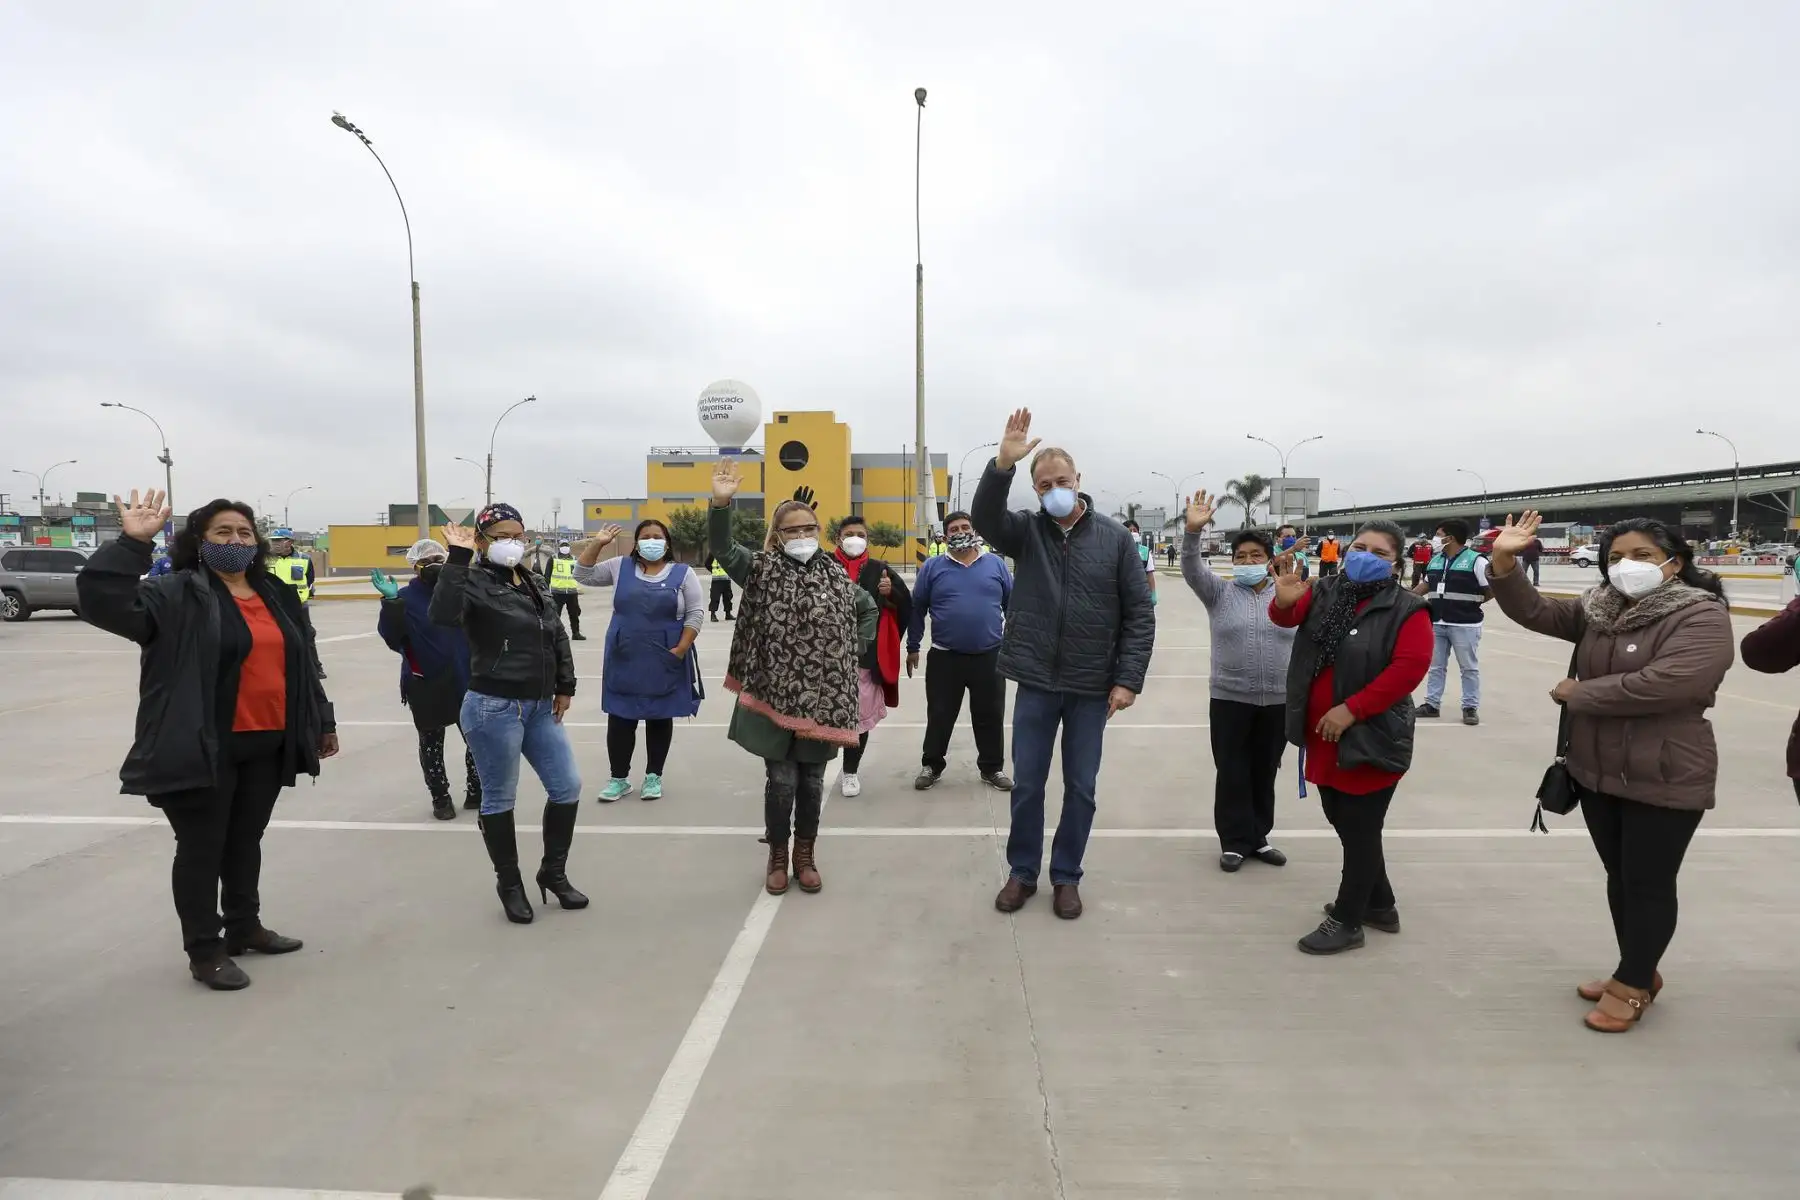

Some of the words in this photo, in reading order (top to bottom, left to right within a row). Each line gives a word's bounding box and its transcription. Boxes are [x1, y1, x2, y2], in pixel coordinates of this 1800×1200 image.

[699, 404, 733, 413] Mayorista
[702, 413, 709, 421] de
[710, 412, 729, 420] Lima
